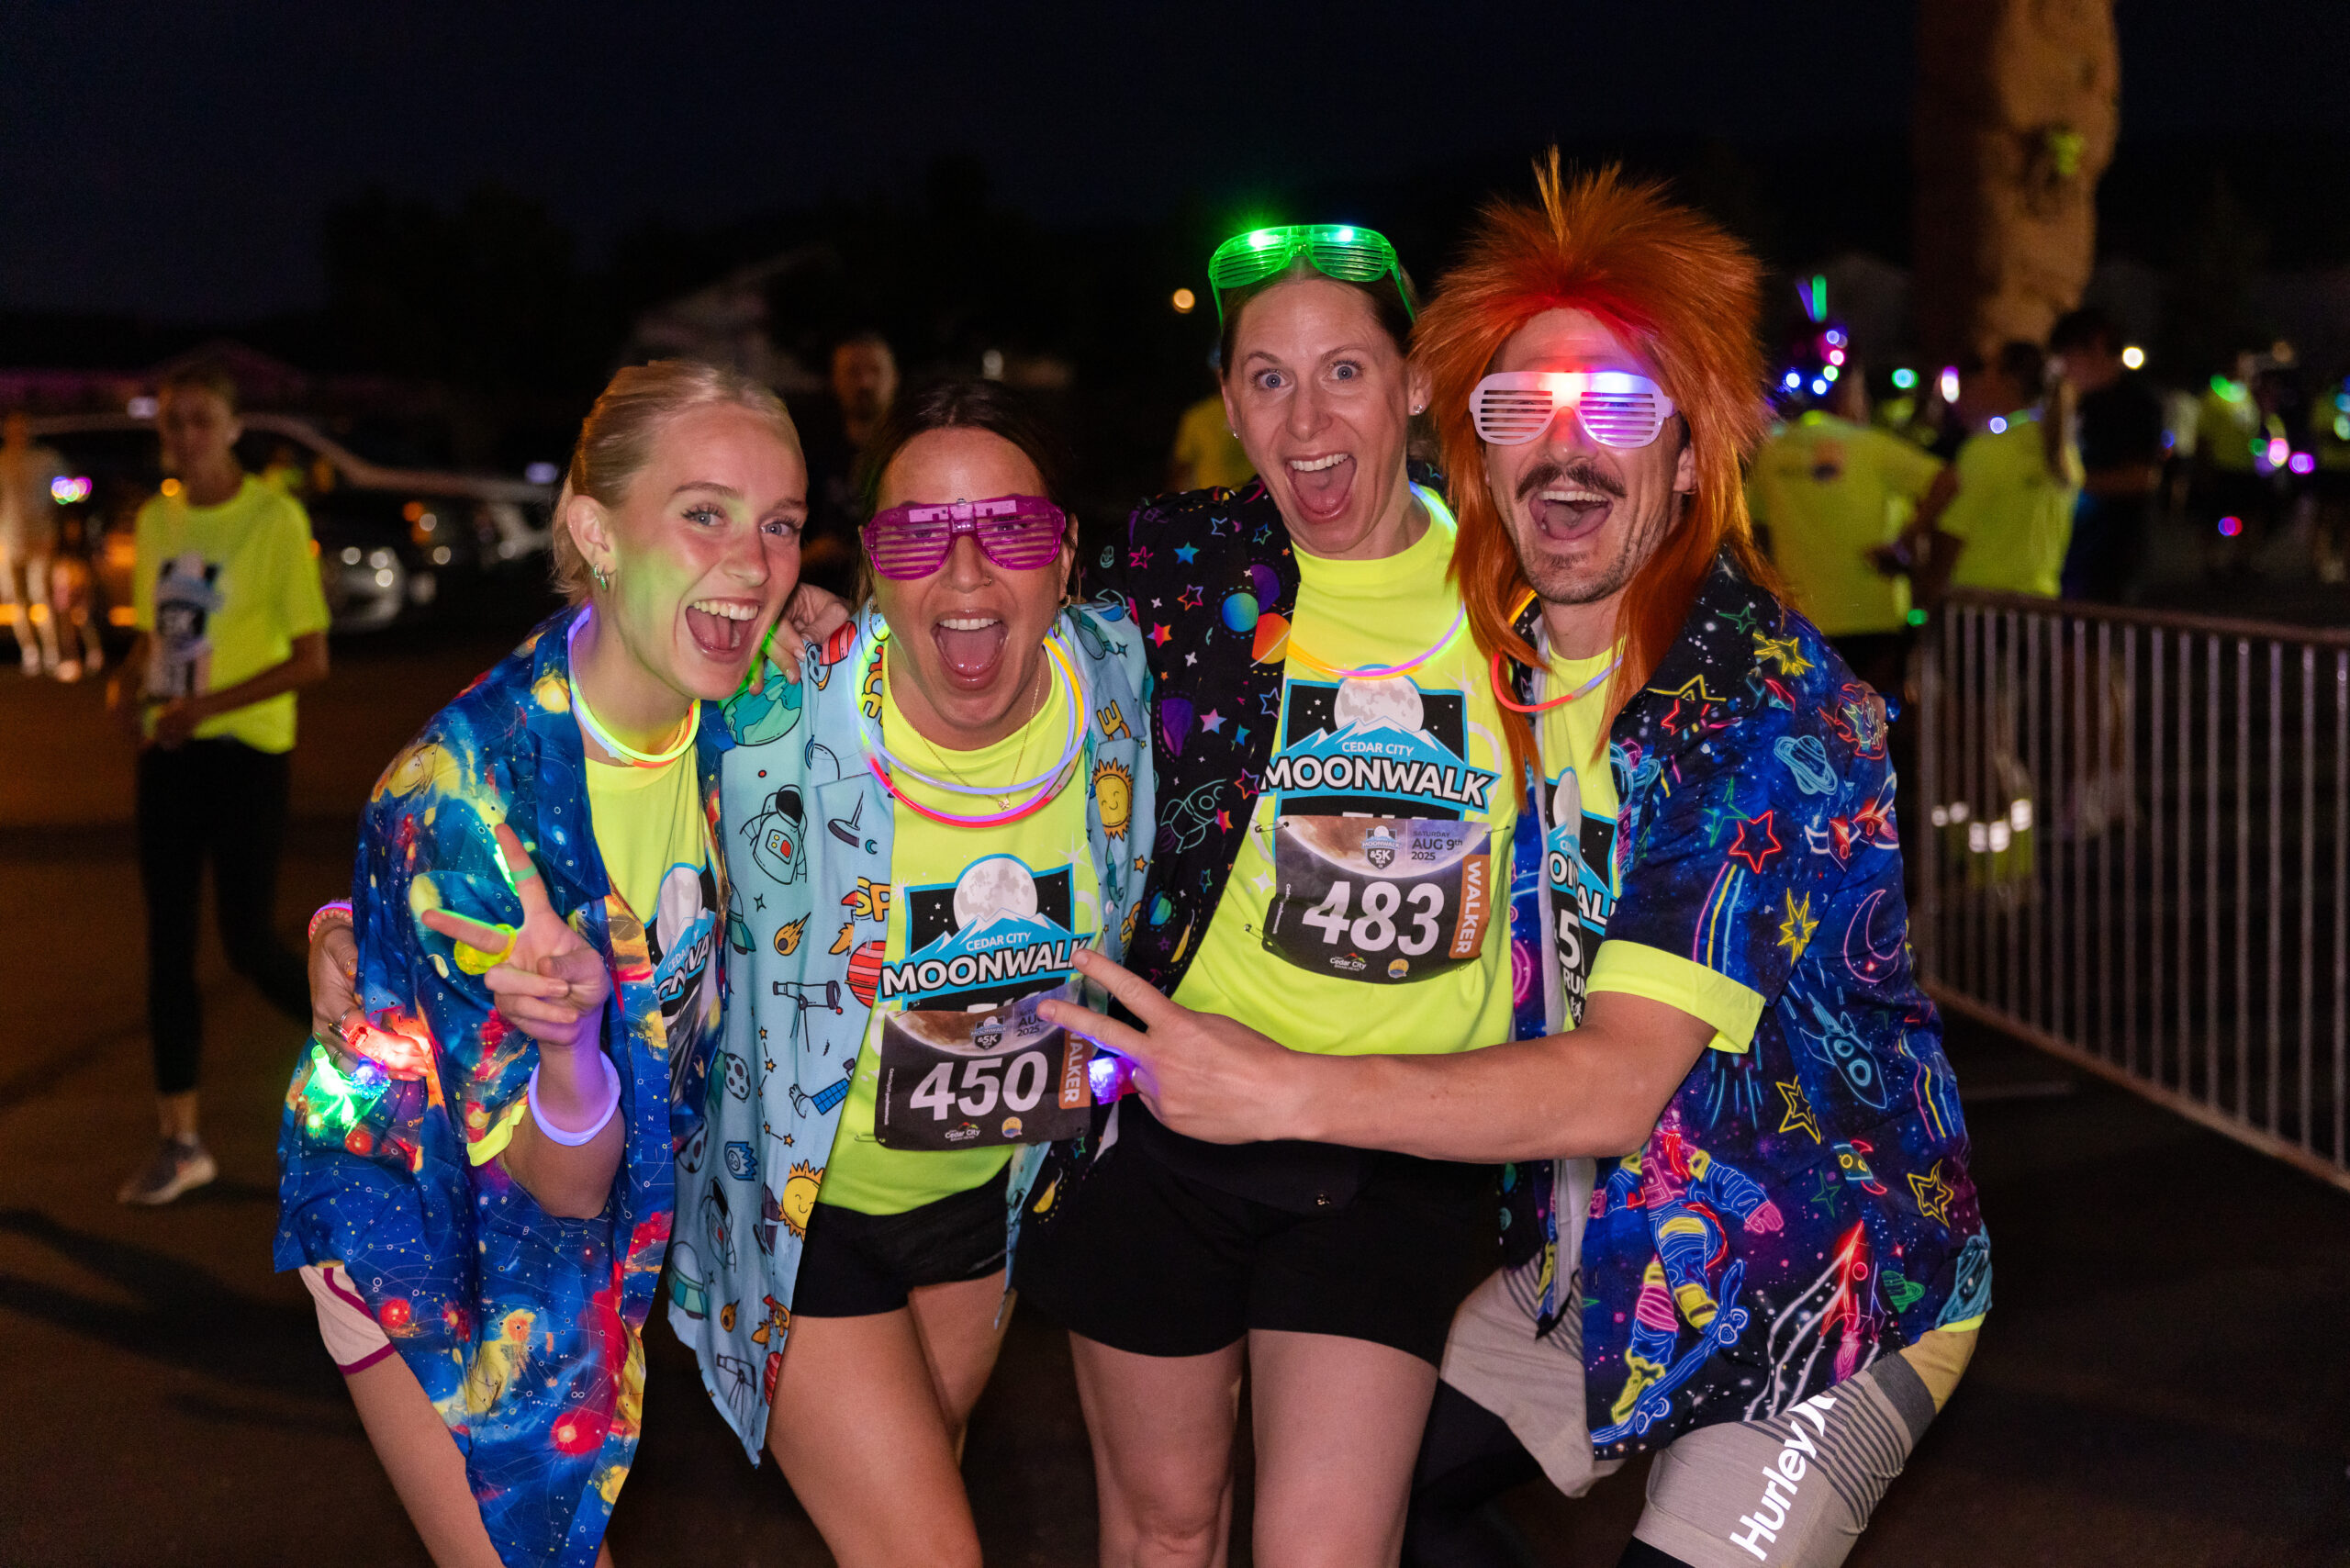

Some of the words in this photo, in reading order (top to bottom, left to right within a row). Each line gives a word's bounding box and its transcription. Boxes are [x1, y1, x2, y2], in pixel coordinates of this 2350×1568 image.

[1341, 741, 1383, 754] CEDAR
[1385, 744, 1415, 756] CITY
[1259, 753, 1492, 808] MOONWALK
[1411, 851, 1436, 861] 2025
[1412, 838, 1443, 850] AUG
[1446, 839, 1463, 851] 9th
[1302, 880, 1445, 957] 483
[1455, 860, 1482, 955] WALKER
[880, 936, 1091, 1000] MOONWALK
[966, 936, 1004, 952] CEDAR
[1005, 932, 1032, 946] CITY
[1016, 1025, 1040, 1037] 2025
[909, 1051, 1048, 1122] 450
[1729, 1419, 1817, 1562] Hurley
